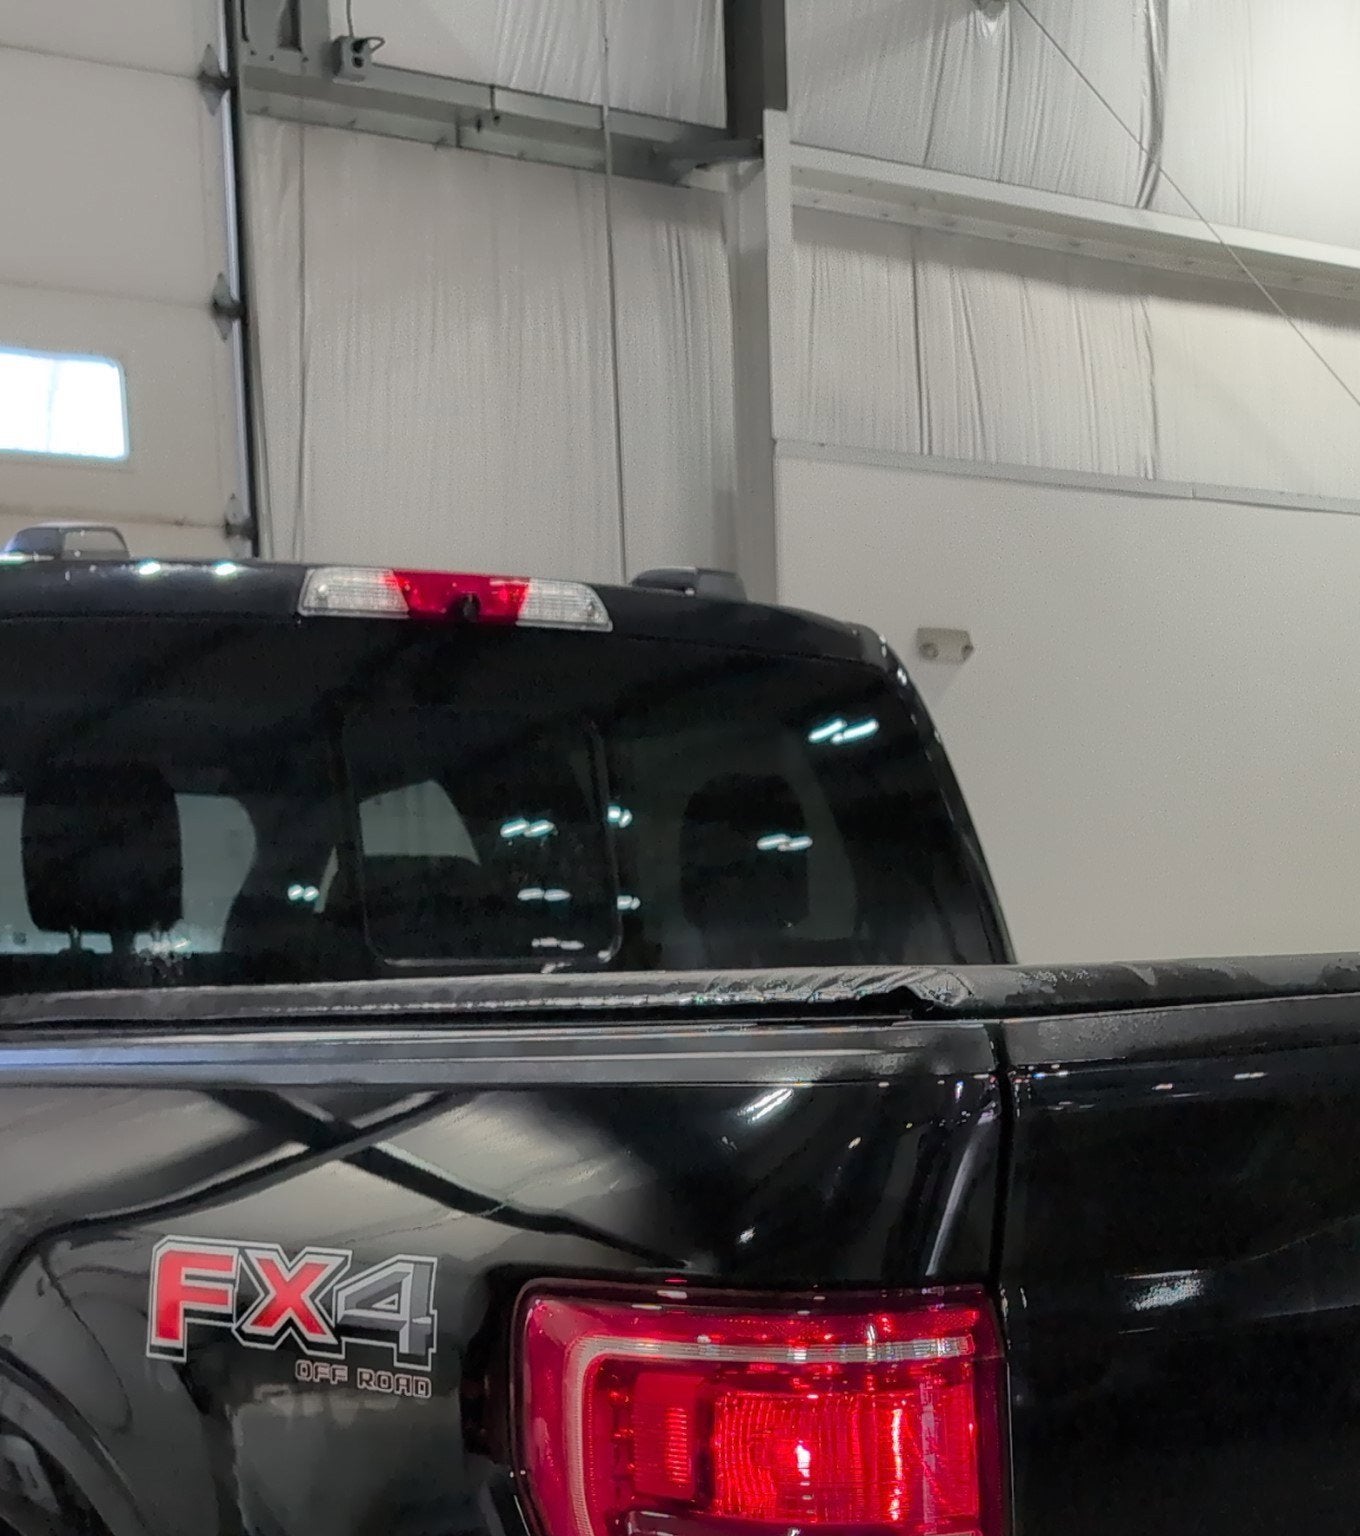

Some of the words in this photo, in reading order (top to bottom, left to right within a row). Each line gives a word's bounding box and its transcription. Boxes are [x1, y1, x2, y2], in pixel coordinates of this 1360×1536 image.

[146, 1234, 438, 1372] FX4
[295, 1359, 348, 1384] OFF
[357, 1367, 432, 1399] ROAD
